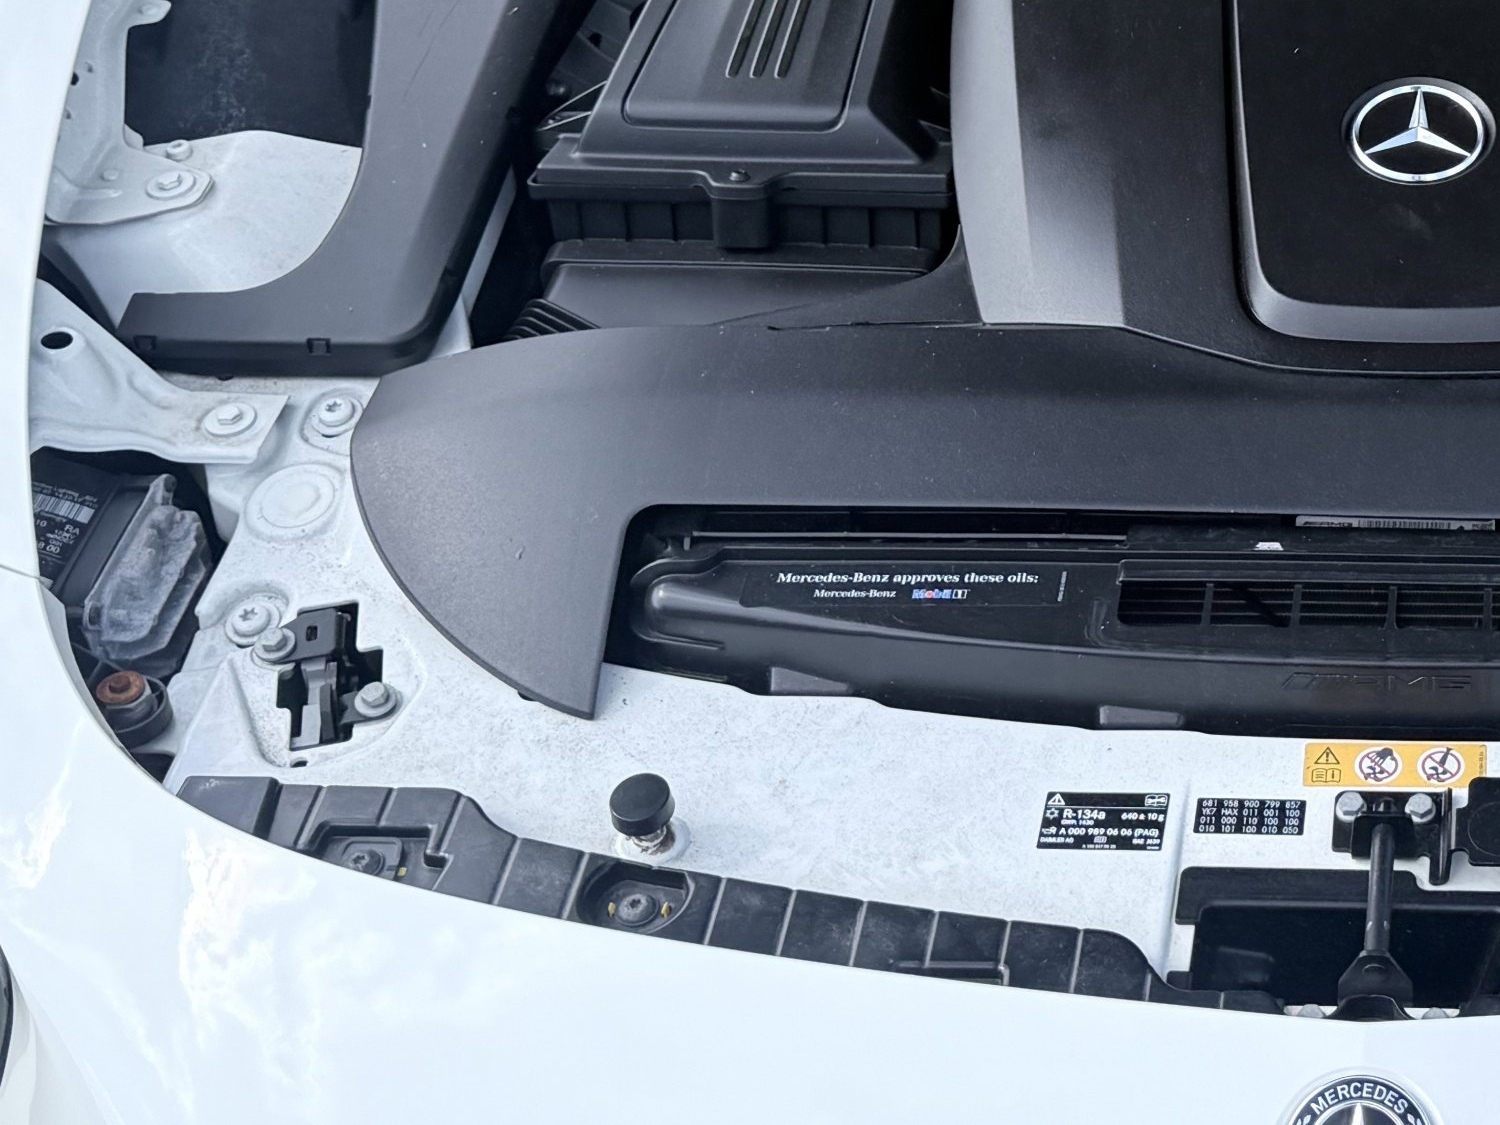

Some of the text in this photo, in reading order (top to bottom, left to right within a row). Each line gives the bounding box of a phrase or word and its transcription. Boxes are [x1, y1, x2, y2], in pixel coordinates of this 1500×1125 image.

[776, 572, 1039, 585] Mercedes-Benz approves these oils:
[813, 589, 897, 598] Mercedes-Benz
[911, 589, 952, 599] Mobil
[1202, 799, 1218, 807] 681
[1223, 799, 1239, 807] 958
[1244, 800, 1260, 808] 900
[1264, 800, 1280, 808] 799
[1063, 808, 1106, 820] R-134a
[1121, 812, 1138, 820] 640
[1147, 812, 1158, 821] 10
[1158, 813, 1165, 823] g
[1221, 808, 1239, 816] HAX
[1243, 808, 1258, 816] 011
[1263, 809, 1279, 817] 001
[1285, 809, 1300, 817] 100
[1200, 816, 1215, 824] 011
[1243, 817, 1258, 825] 110
[1264, 817, 1278, 825] 100
[1285, 818, 1299, 826] 100
[1059, 827, 1159, 838] A 000 989 06 06 (PAG)
[1221, 825, 1235, 833] 101
[1242, 825, 1257, 833] 100
[1261, 826, 1278, 834] 010
[1282, 826, 1299, 834] 050
[1310, 1082, 1408, 1115] MERCEDES
